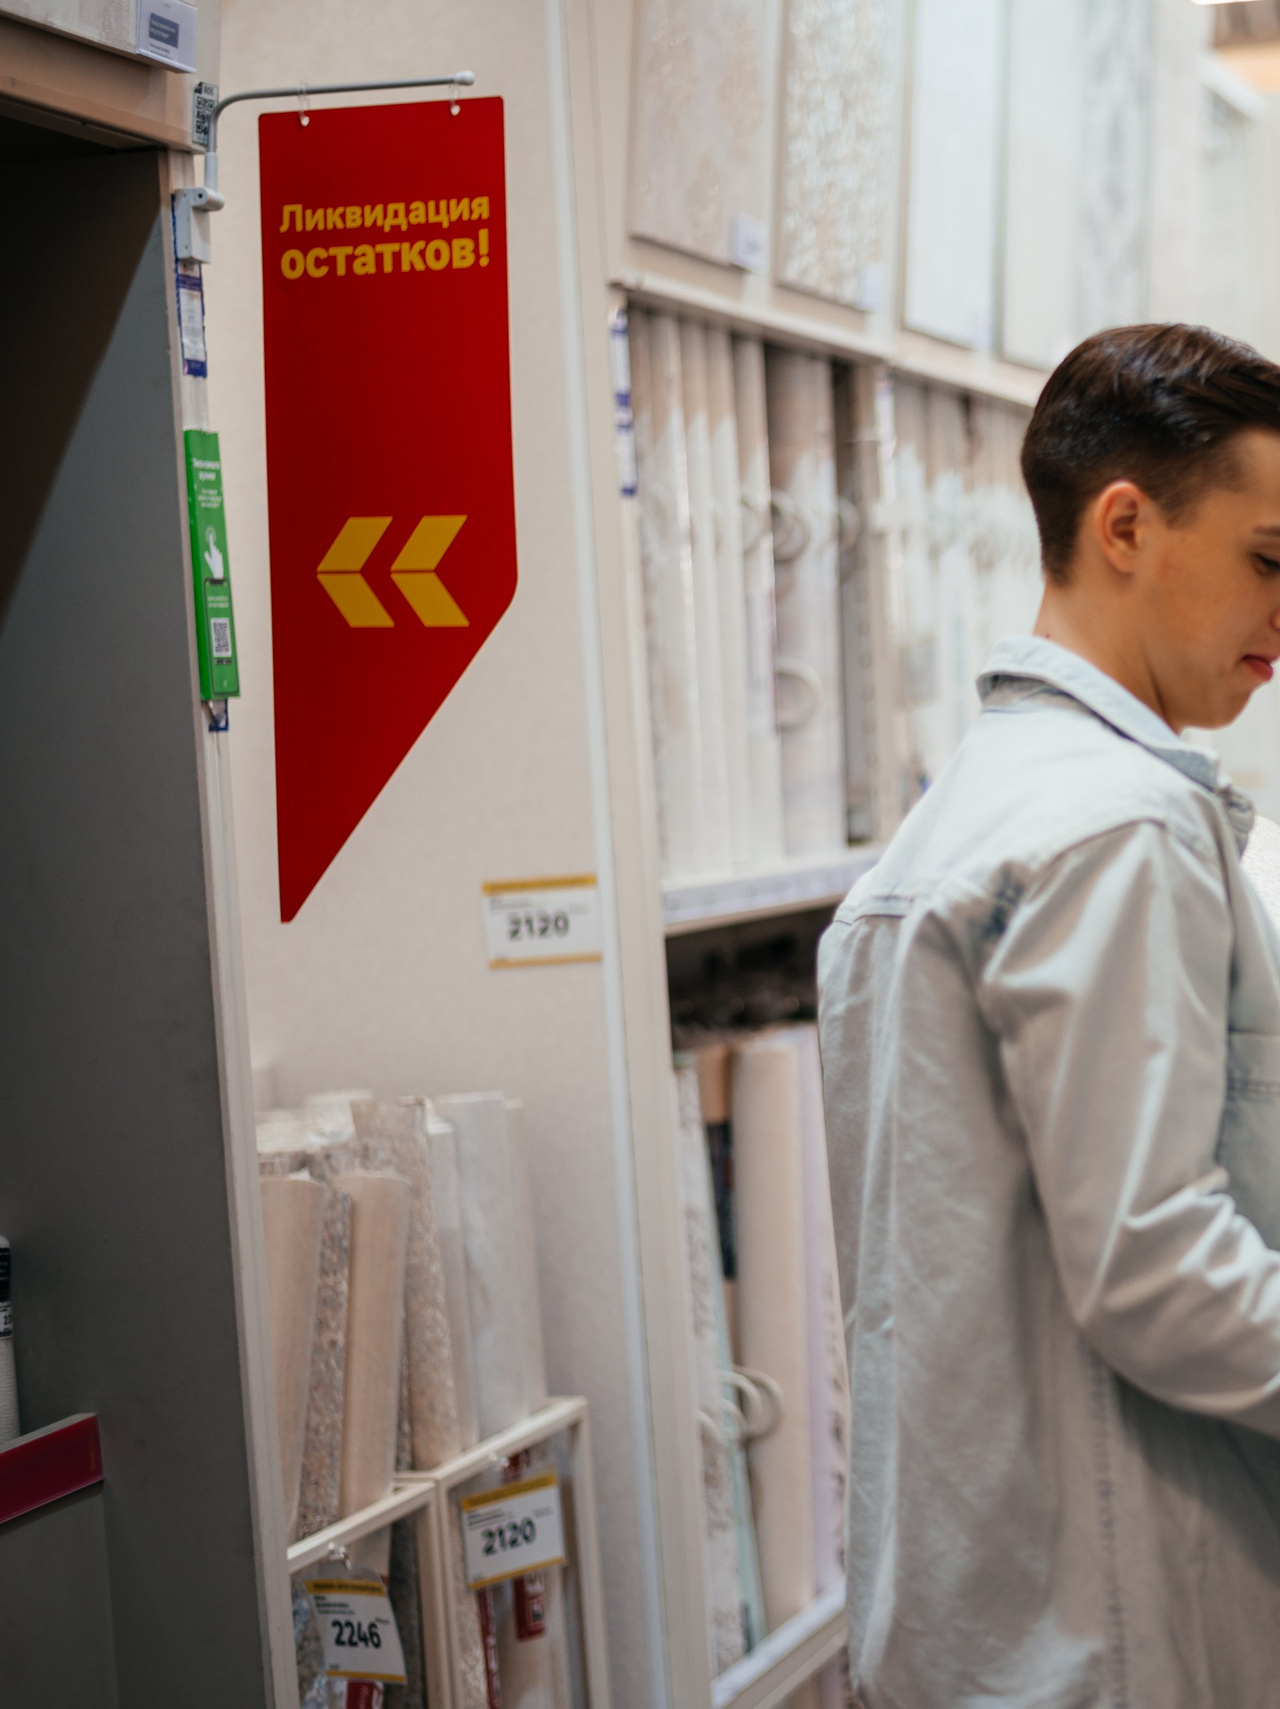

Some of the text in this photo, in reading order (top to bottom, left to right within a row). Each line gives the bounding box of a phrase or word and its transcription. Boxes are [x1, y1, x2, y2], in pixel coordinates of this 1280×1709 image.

[279, 196, 490, 233] Ликвидация
[280, 228, 490, 280] остатков!
[508, 911, 570, 940] 2120
[481, 1517, 536, 1555] 2120
[331, 1619, 382, 1649] 2246
